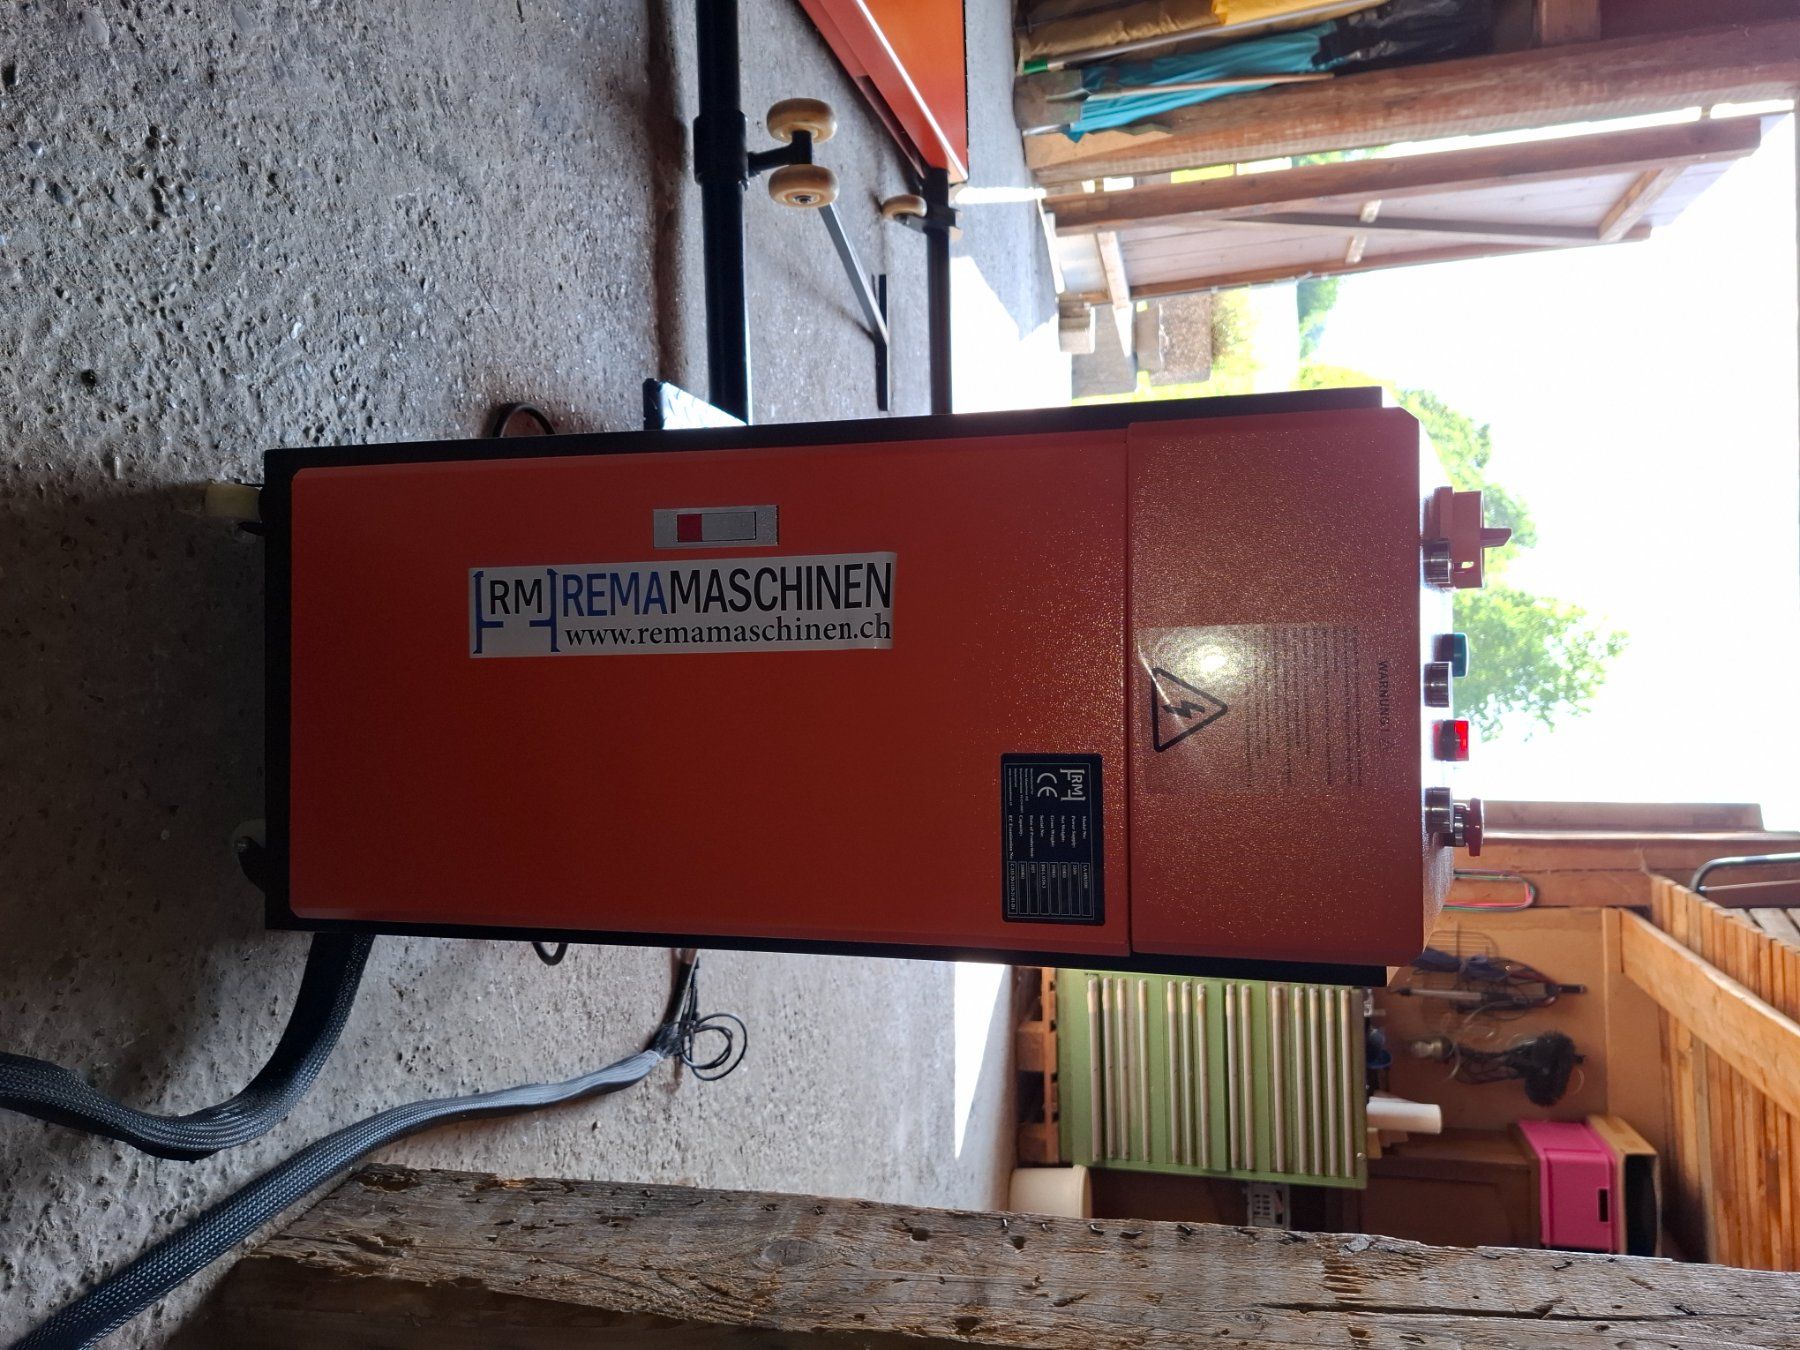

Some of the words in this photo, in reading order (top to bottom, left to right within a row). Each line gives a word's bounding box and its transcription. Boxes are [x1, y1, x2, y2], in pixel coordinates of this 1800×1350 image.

[489, 578, 543, 615] RM
[562, 562, 892, 617] REMAMASCHINEN
[565, 612, 892, 646] www.remamaschinen.ch
[1378, 660, 1390, 727] WARNUNG
[1071, 774, 1083, 796] RM
